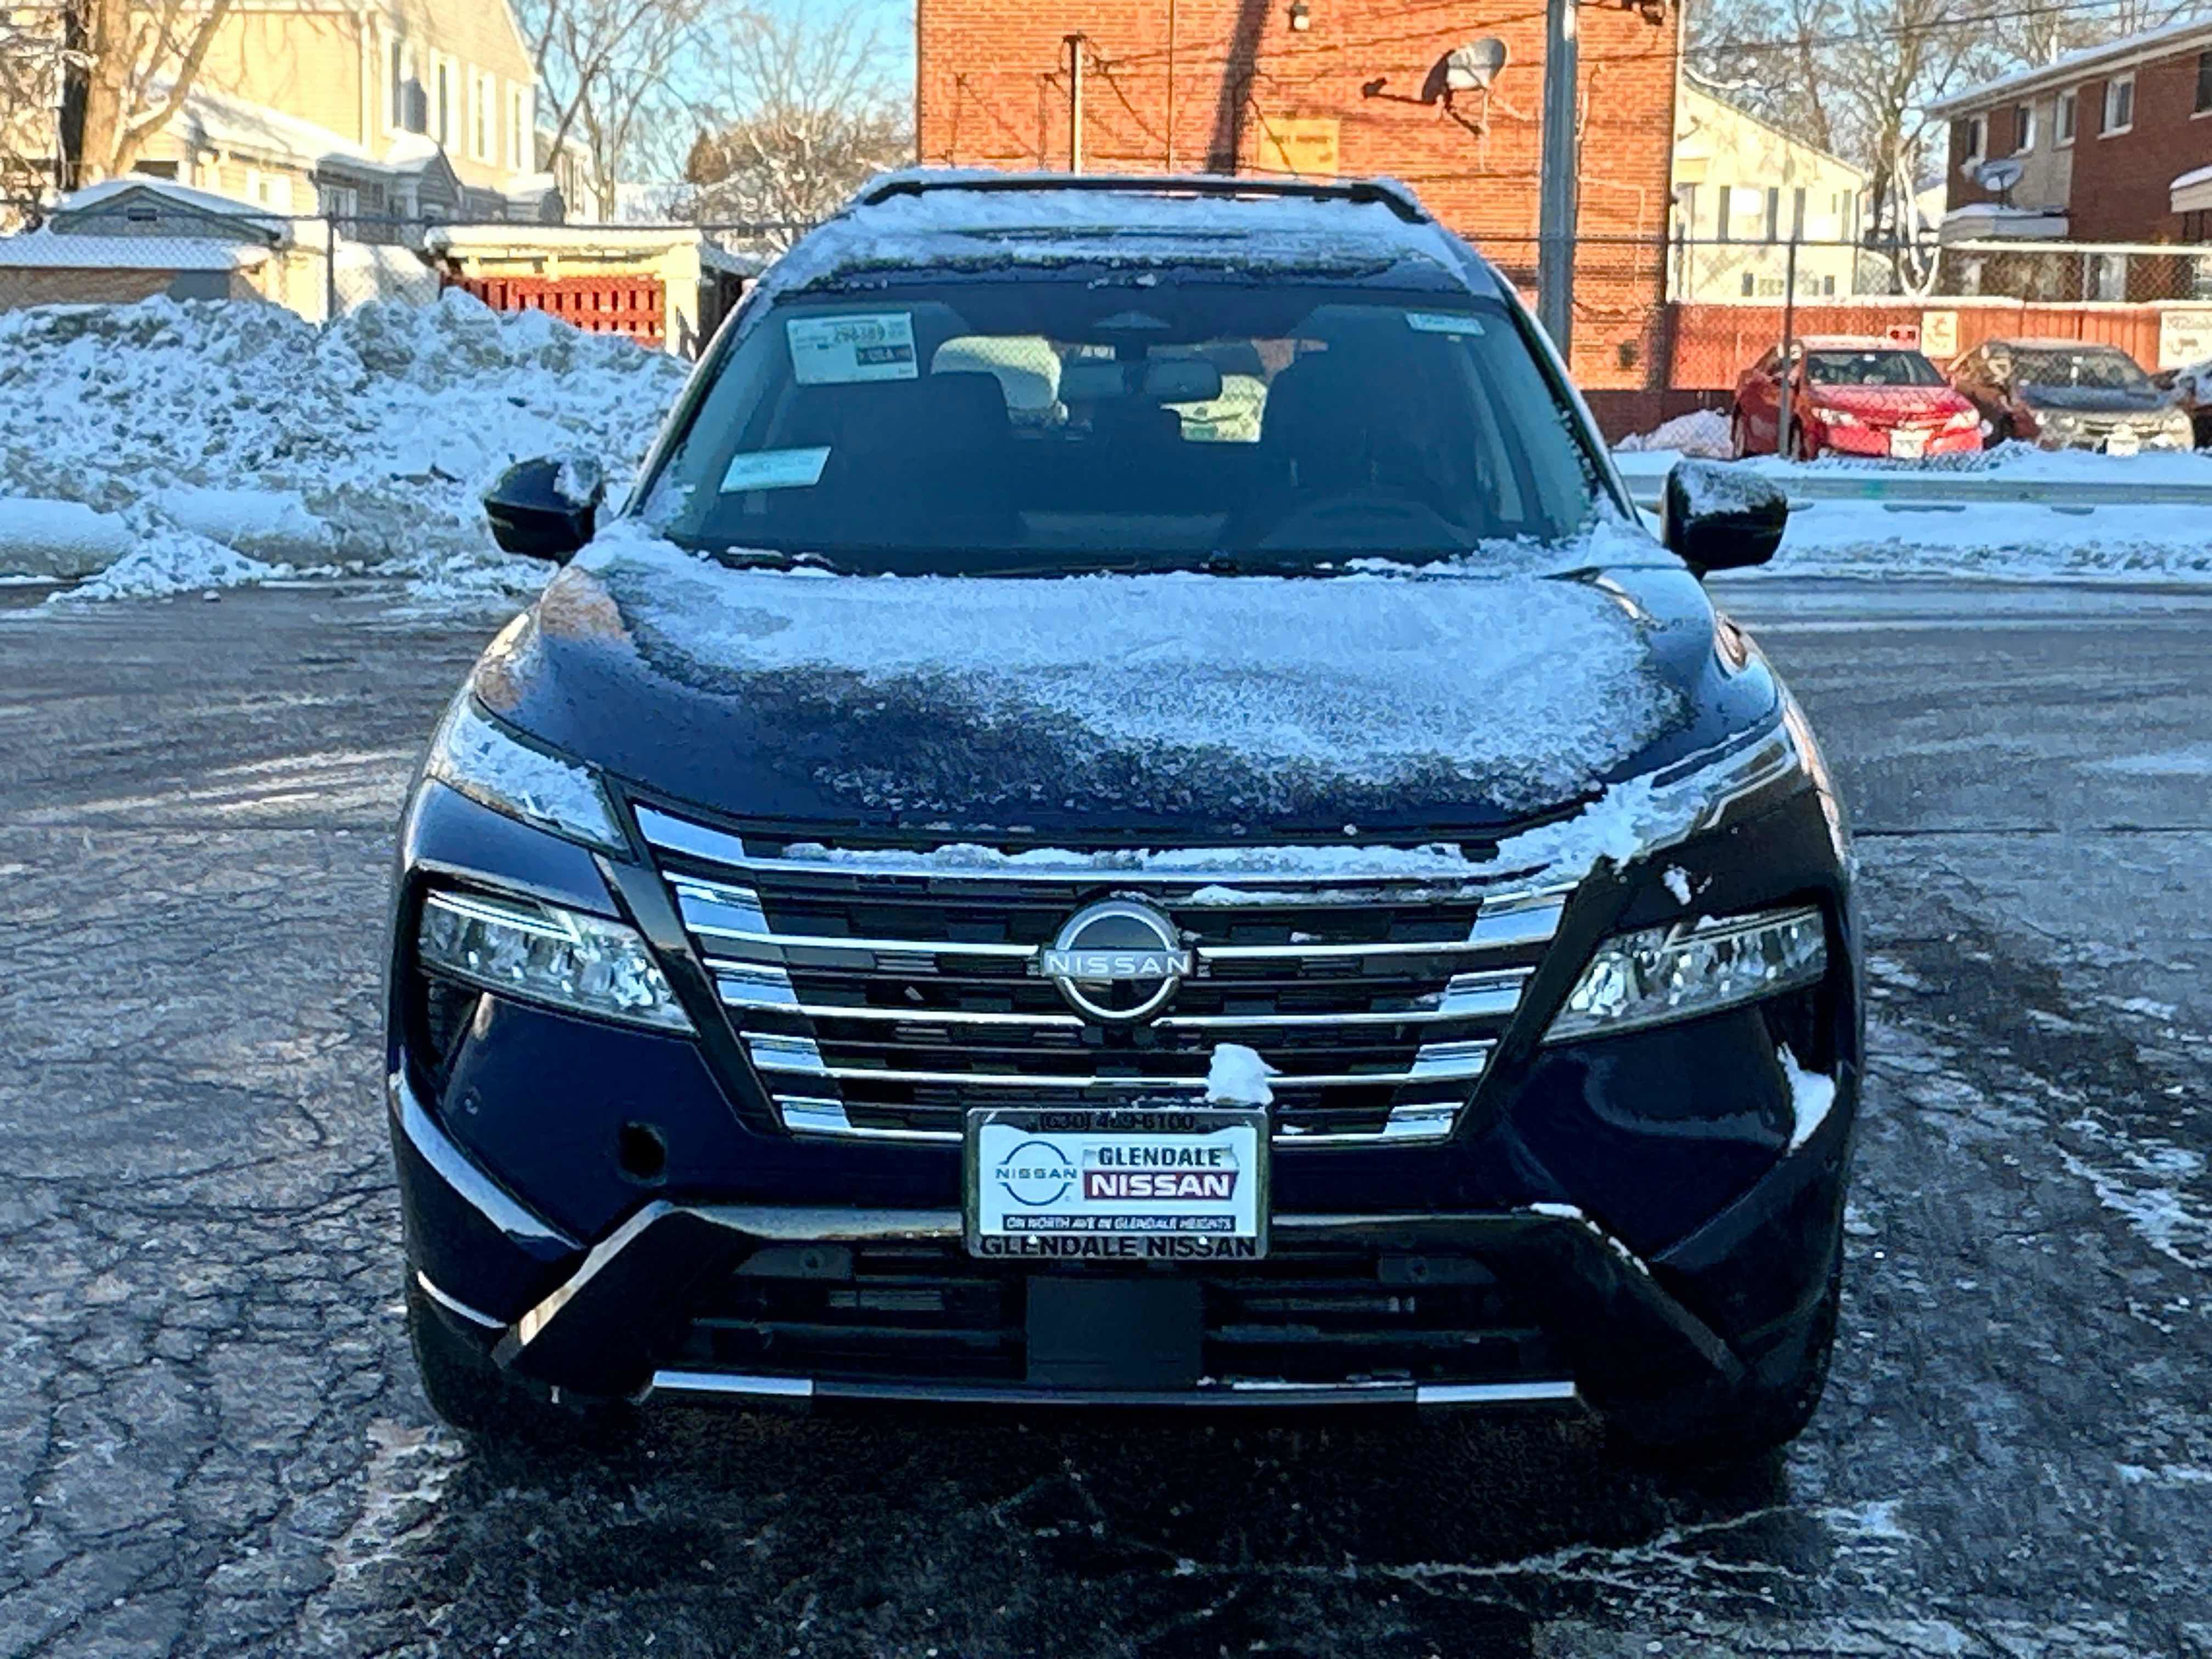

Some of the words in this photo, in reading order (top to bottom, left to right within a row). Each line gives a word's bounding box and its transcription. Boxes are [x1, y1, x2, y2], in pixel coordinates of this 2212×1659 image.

[1048, 956, 1188, 974] NISSAN
[1098, 1147, 1221, 1166] GLENDALE
[995, 1168, 1077, 1179] NISSAN
[1091, 1174, 1229, 1197] NISSAN
[1028, 1217, 1069, 1229] NORTH
[1114, 1216, 1177, 1229] GLENDALE
[1179, 1216, 1232, 1229] HEIGHTS
[980, 1235, 1137, 1256] GLENDALE
[1147, 1236, 1256, 1256] NISSAN
